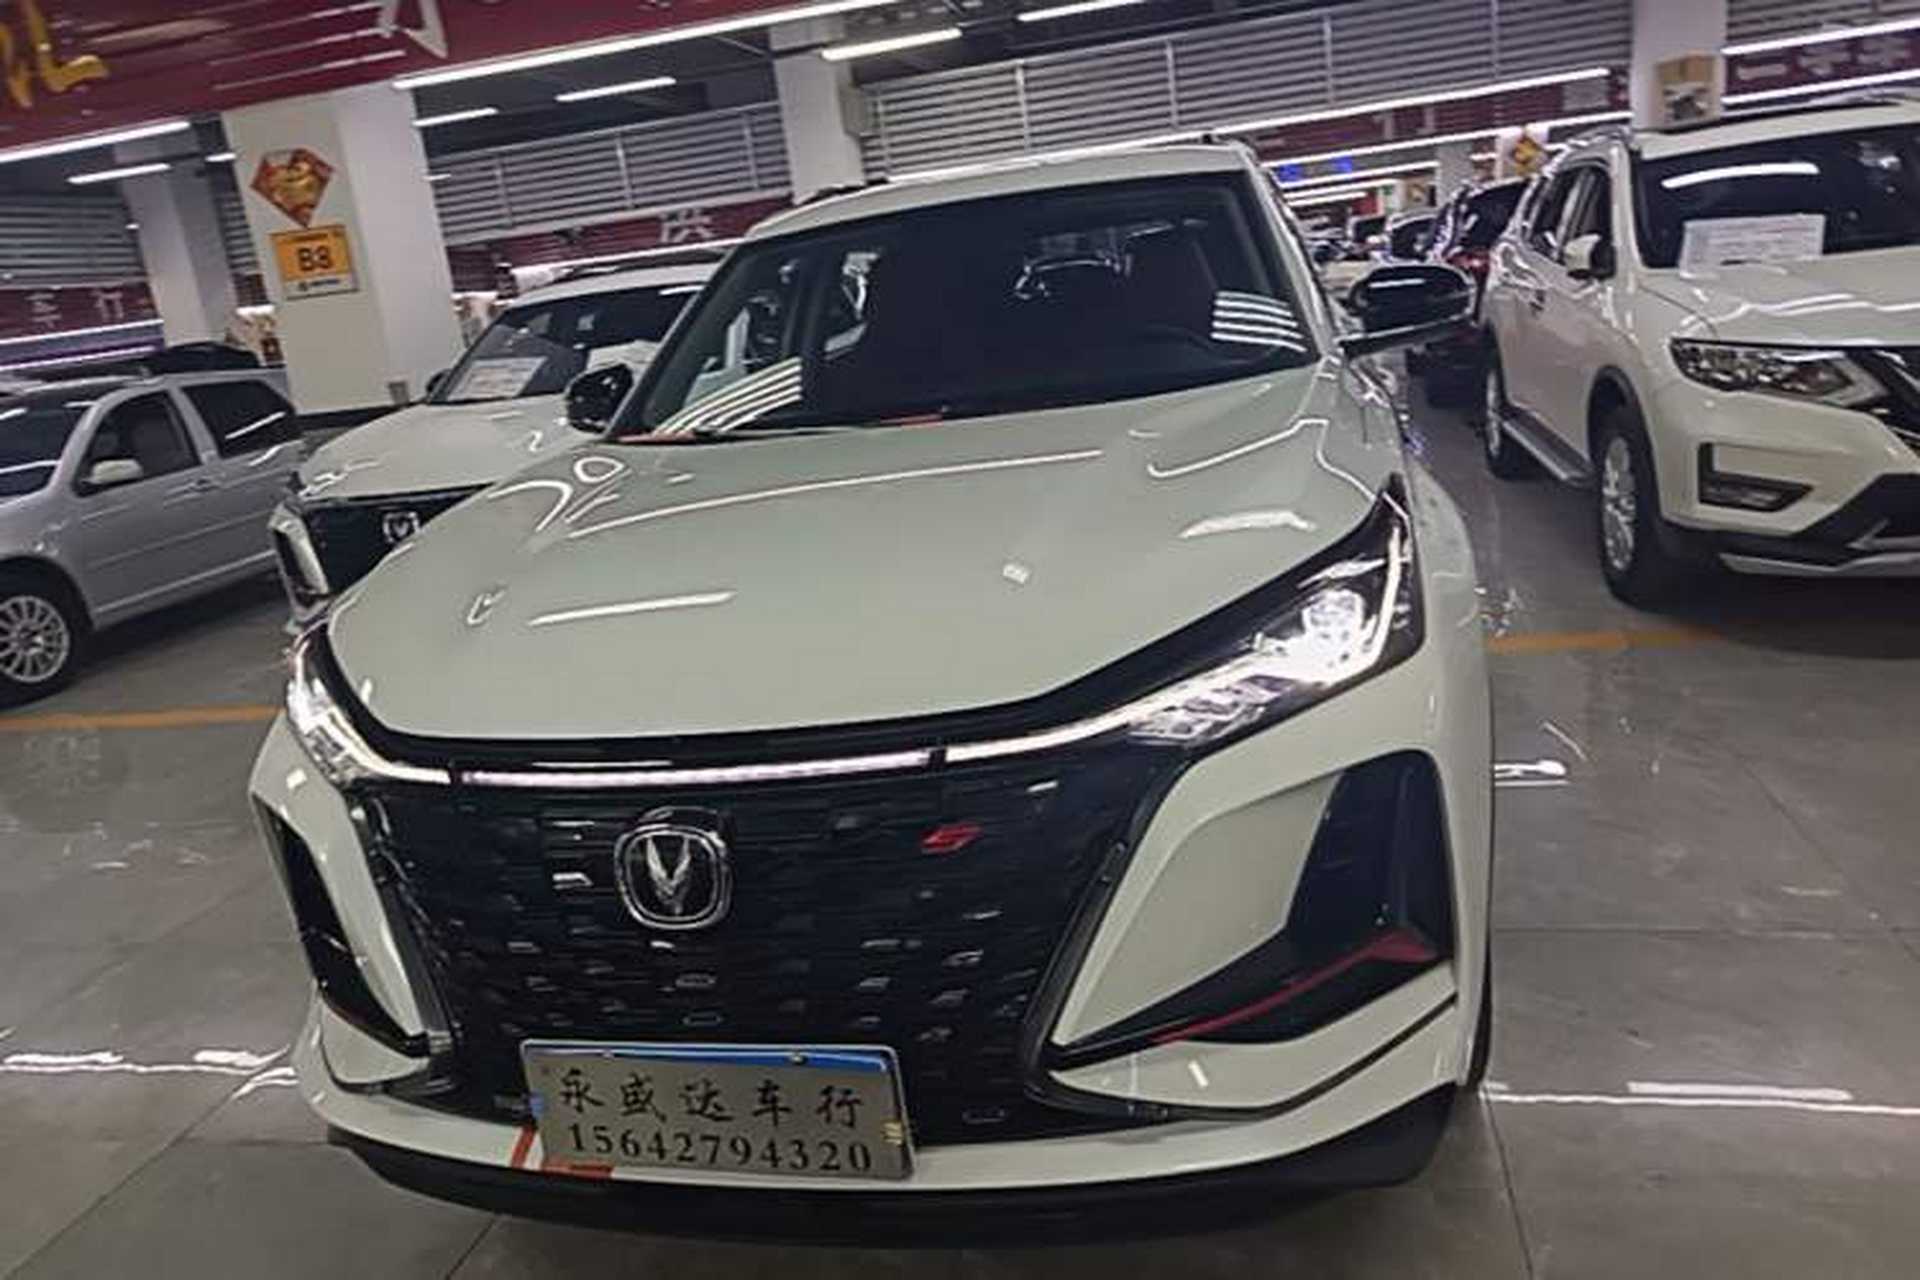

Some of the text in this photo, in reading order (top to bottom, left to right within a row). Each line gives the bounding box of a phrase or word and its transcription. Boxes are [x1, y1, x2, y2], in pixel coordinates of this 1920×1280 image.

[558, 1068, 864, 1129] 永盛达车行
[567, 1123, 872, 1172] 15642794320
